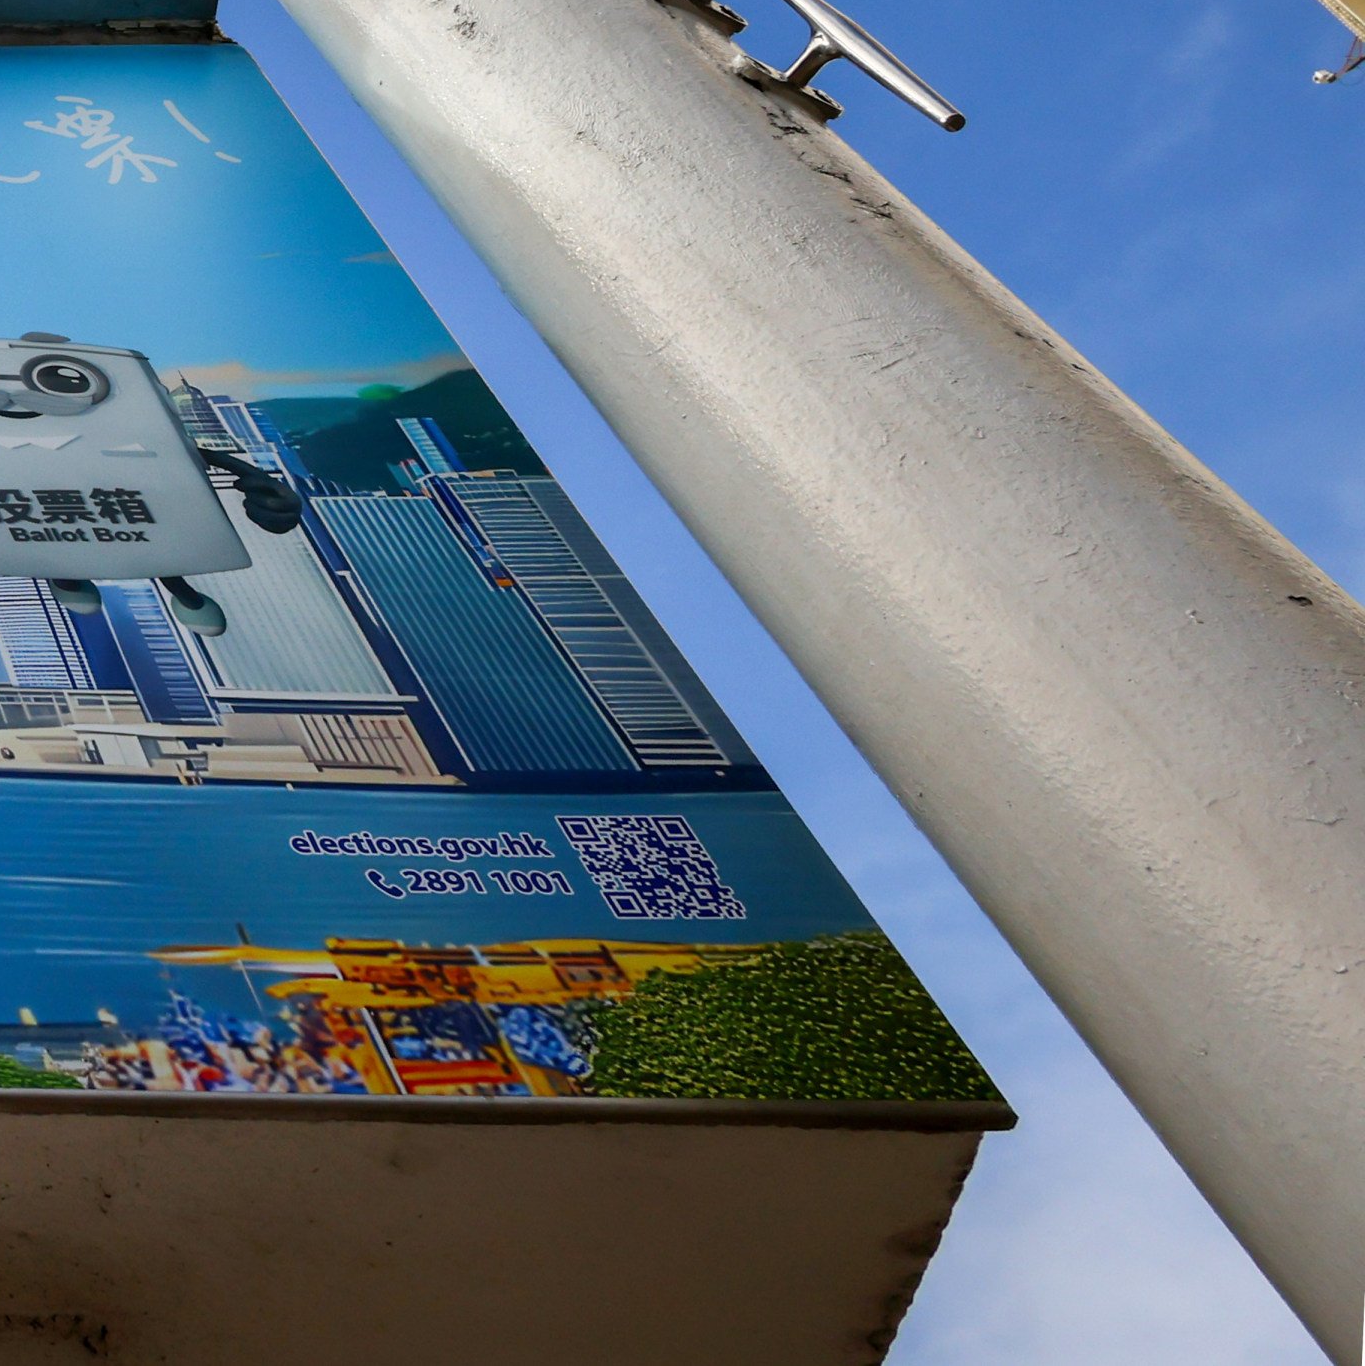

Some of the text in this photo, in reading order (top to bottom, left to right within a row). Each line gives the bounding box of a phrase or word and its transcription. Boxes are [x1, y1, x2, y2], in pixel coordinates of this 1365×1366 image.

[8, 527, 150, 542] Ballot Box
[291, 831, 552, 861] elections.gov.hk
[401, 870, 573, 894] 2891 1001
